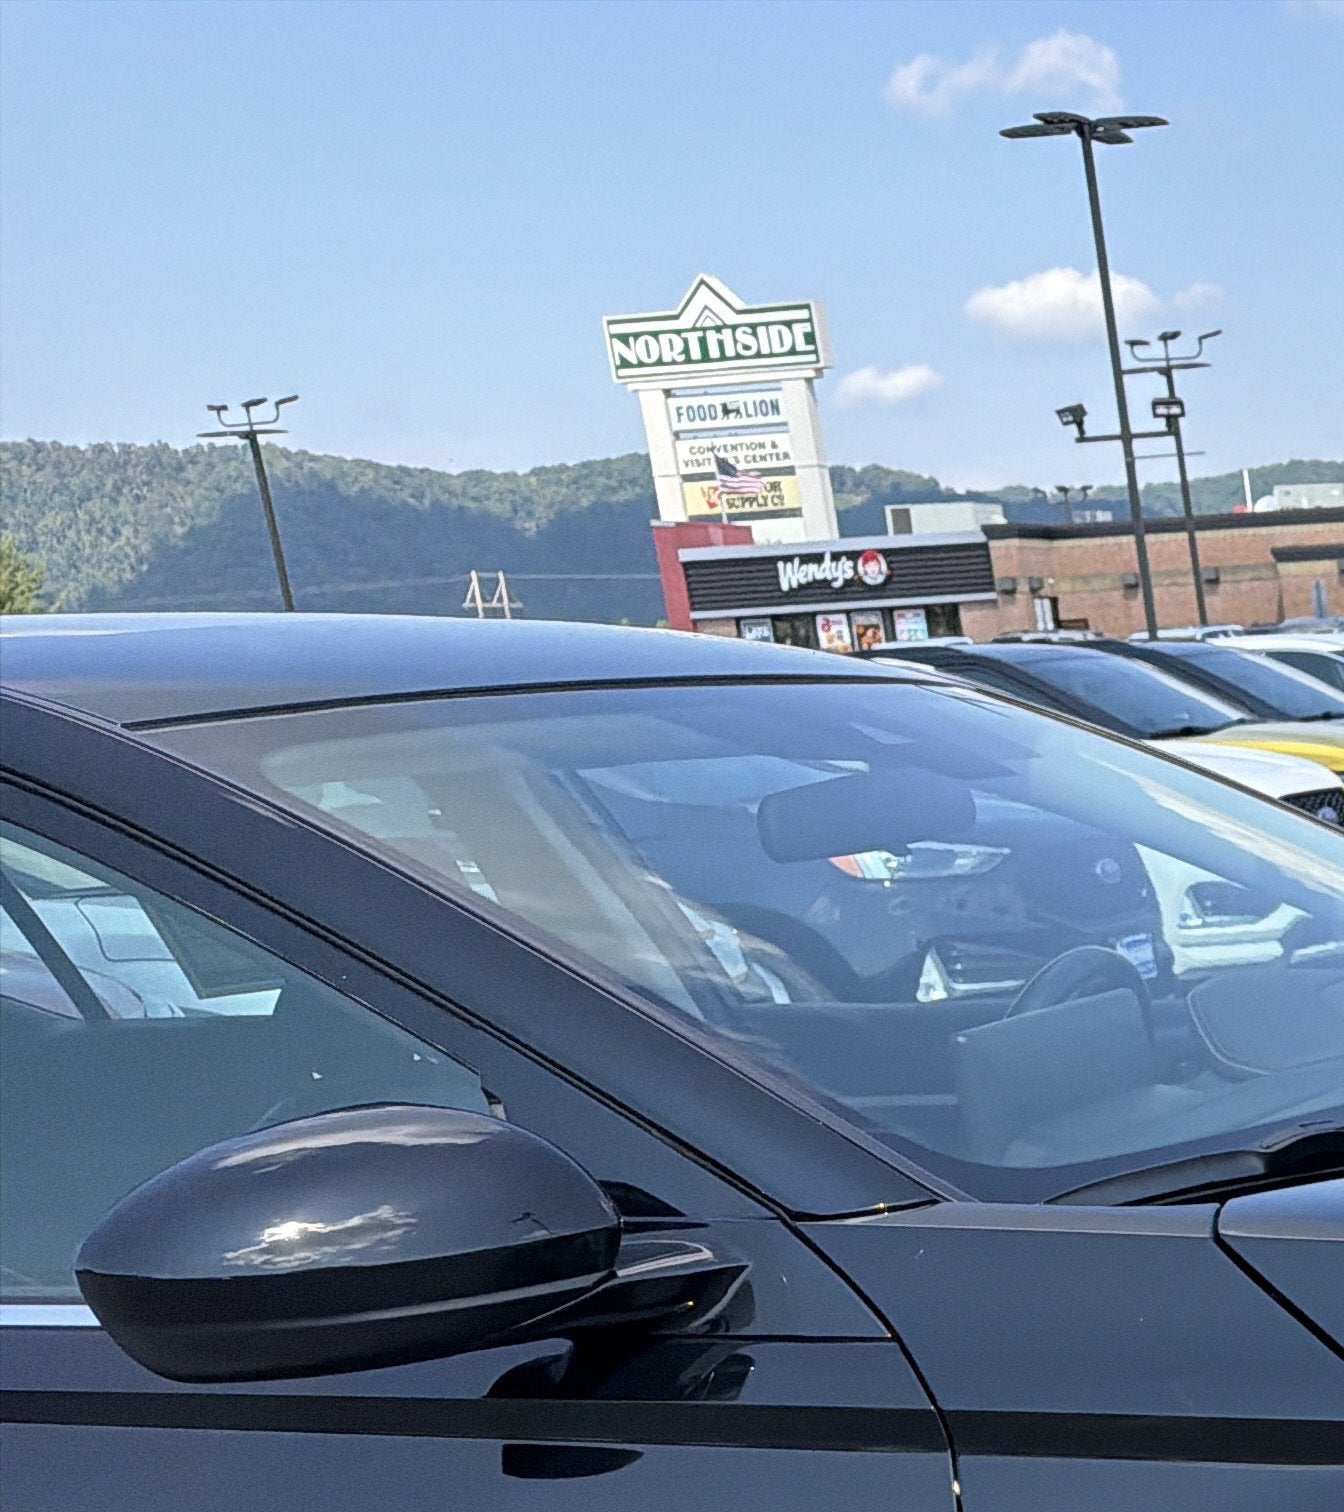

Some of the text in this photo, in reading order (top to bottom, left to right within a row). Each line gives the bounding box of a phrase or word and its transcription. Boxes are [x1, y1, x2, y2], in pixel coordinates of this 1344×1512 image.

[611, 322, 815, 366] NORTHSIDE
[675, 398, 781, 424] FOOD LION
[689, 440, 779, 456] CONVENTION &
[744, 451, 791, 465] CENTER
[776, 550, 855, 592] Wendy's
